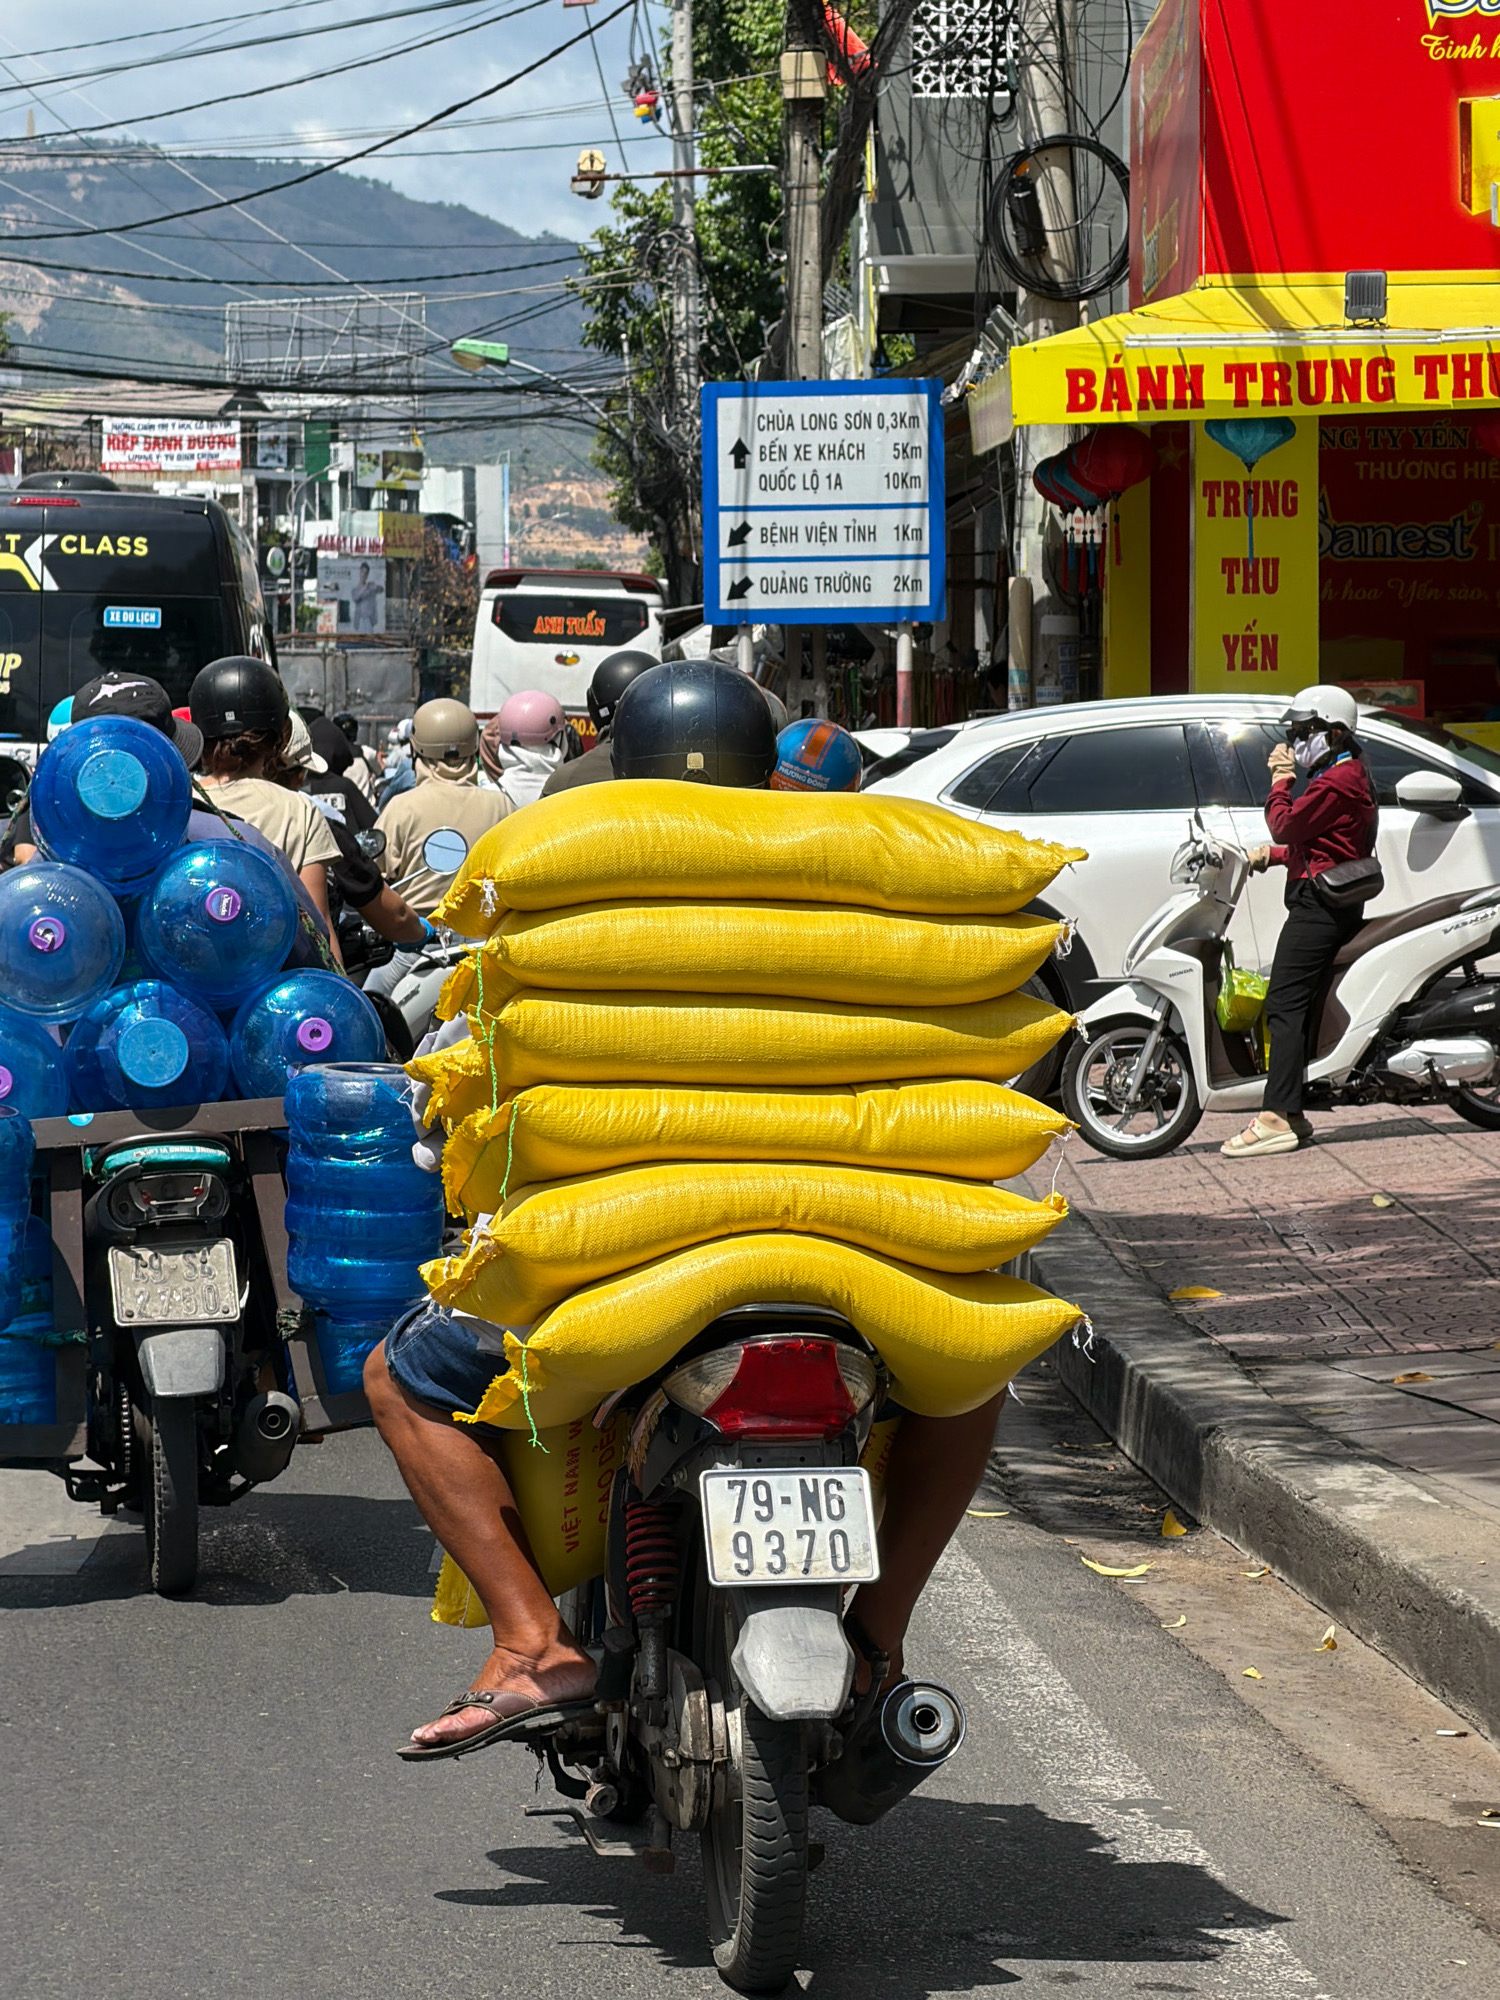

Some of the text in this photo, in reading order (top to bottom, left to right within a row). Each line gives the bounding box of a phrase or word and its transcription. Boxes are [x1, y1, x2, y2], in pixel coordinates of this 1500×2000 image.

[1421, 33, 1487, 61] Tinh
[1065, 354, 1205, 413] BÁNH
[1224, 357, 1396, 409] TRUNG
[757, 409, 920, 433] CHÙA LONG SƠN 0,3Km
[1366, 427, 1404, 449] TY
[1409, 418, 1472, 449] YẾN
[759, 437, 922, 462] BẾN XE KHÁCH 5Km
[759, 467, 922, 494] QUỐC LỘ 1A 10Km
[1355, 459, 1457, 480] THƯƠNG
[1202, 480, 1299, 518] TRUNG
[60, 535, 148, 556] CLASS
[760, 519, 923, 546] BỆNH VIỆN TỈNH 1Km
[760, 570, 923, 594] QUẢNG TRƯỜNG 2Km
[1221, 557, 1280, 595] THU
[109, 611, 156, 625] XE DU LỊCH
[533, 609, 606, 636] ANH TUẤN
[1222, 619, 1279, 671] YẾN
[1169, 967, 1194, 978] HONDA
[564, 1447, 581, 1497] NAM
[561, 1506, 582, 1555] VIỆT
[732, 1528, 851, 1576] 9370
